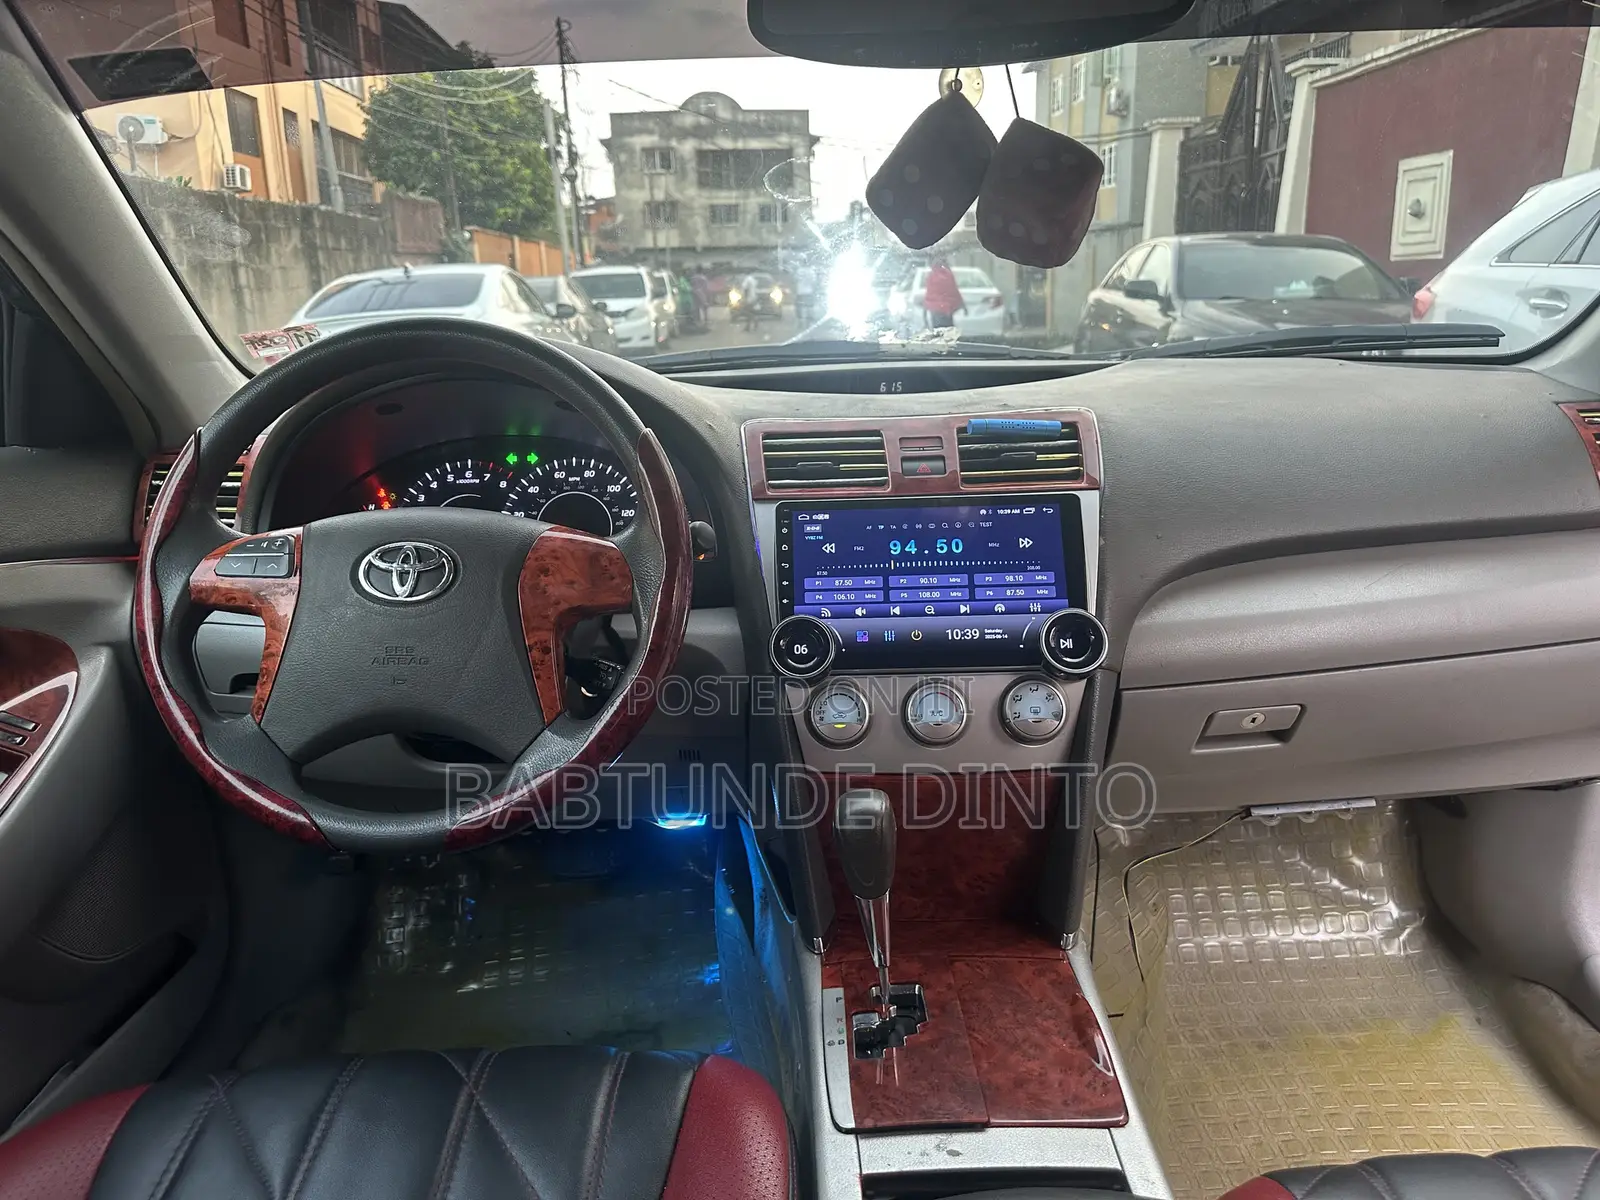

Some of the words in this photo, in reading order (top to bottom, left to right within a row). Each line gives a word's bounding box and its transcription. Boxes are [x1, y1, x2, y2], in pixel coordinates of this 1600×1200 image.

[446, 474, 455, 482] 5
[553, 471, 566, 479] 60
[583, 470, 596, 478] 80
[429, 481, 438, 489] 4
[499, 480, 507, 488] 8
[527, 486, 540, 494] 40
[607, 485, 621, 493] 100
[417, 494, 425, 502] 3
[621, 509, 635, 517] 120
[945, 628, 980, 640] 10:39
[793, 644, 808, 655] 06
